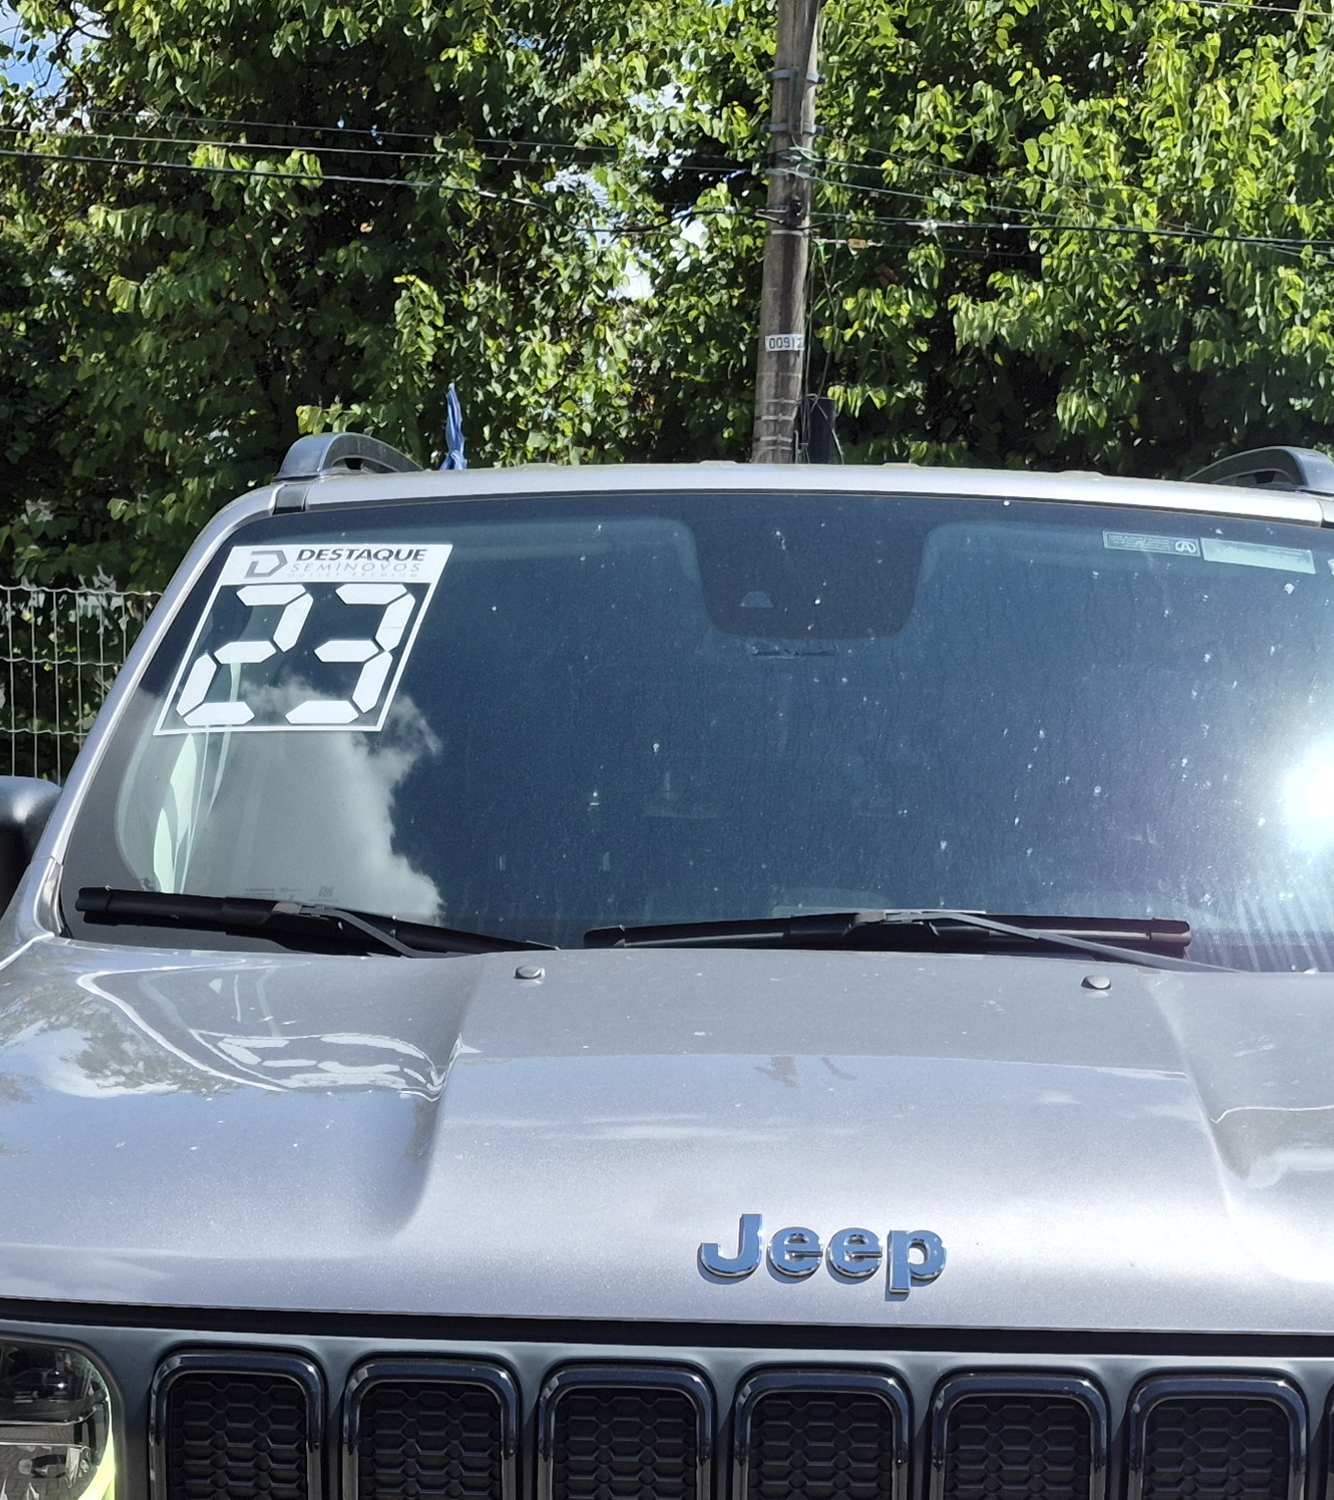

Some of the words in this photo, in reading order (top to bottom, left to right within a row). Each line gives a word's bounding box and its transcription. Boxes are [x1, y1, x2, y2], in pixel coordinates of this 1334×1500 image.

[290, 562, 421, 573] SEMINOVOS
[295, 548, 428, 562] DESTAQUE
[175, 583, 416, 726] 23
[697, 1213, 947, 1301] Jeep
